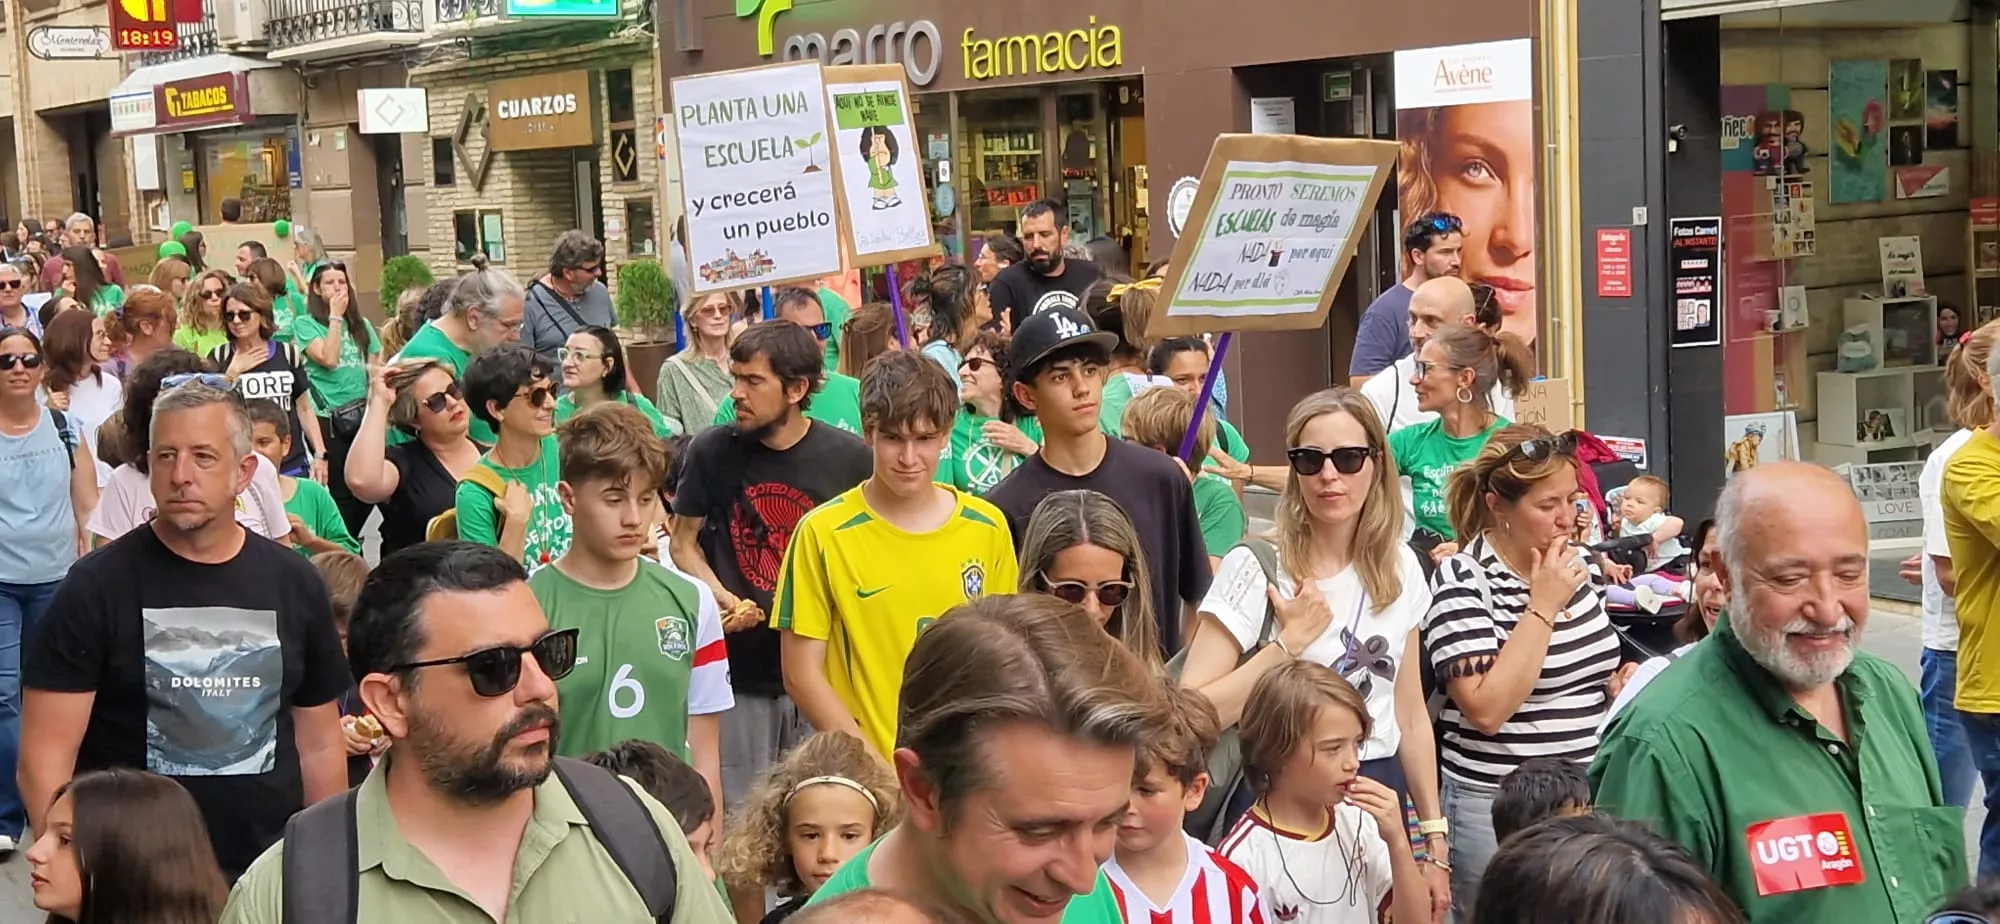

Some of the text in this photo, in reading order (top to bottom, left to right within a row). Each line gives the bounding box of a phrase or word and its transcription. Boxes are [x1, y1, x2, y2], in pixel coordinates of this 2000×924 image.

[121, 30, 174, 46] 18:19
[961, 15, 1122, 79] farmacia
[1433, 59, 1493, 88] Avène
[180, 85, 228, 109] TABACOS
[498, 93, 577, 118] CUARZOS
[853, 95, 864, 109] NO
[866, 95, 875, 108] SE
[876, 93, 898, 107] RINDE
[680, 91, 809, 128] PLANTA UNA
[704, 135, 796, 168] ESCUELA
[692, 181, 797, 217] y crecerá
[1229, 182, 1359, 202] PRONTO SEREMOS
[723, 222, 750, 240] un
[756, 210, 831, 239] pueblo
[1215, 208, 1341, 237] ESCUELAS de magia
[1674, 225, 1718, 237] Fotos Carnet
[1236, 242, 1270, 264] NADA
[1187, 271, 1233, 292] NADA
[1049, 312, 1081, 339] LA
[1877, 501, 1915, 515] LOVE
[171, 676, 261, 688] DOLOMITES
[201, 688, 233, 697] ITALY
[609, 664, 645, 718] 6
[1757, 833, 1814, 865] UGT
[1820, 857, 1854, 871] Aragón
